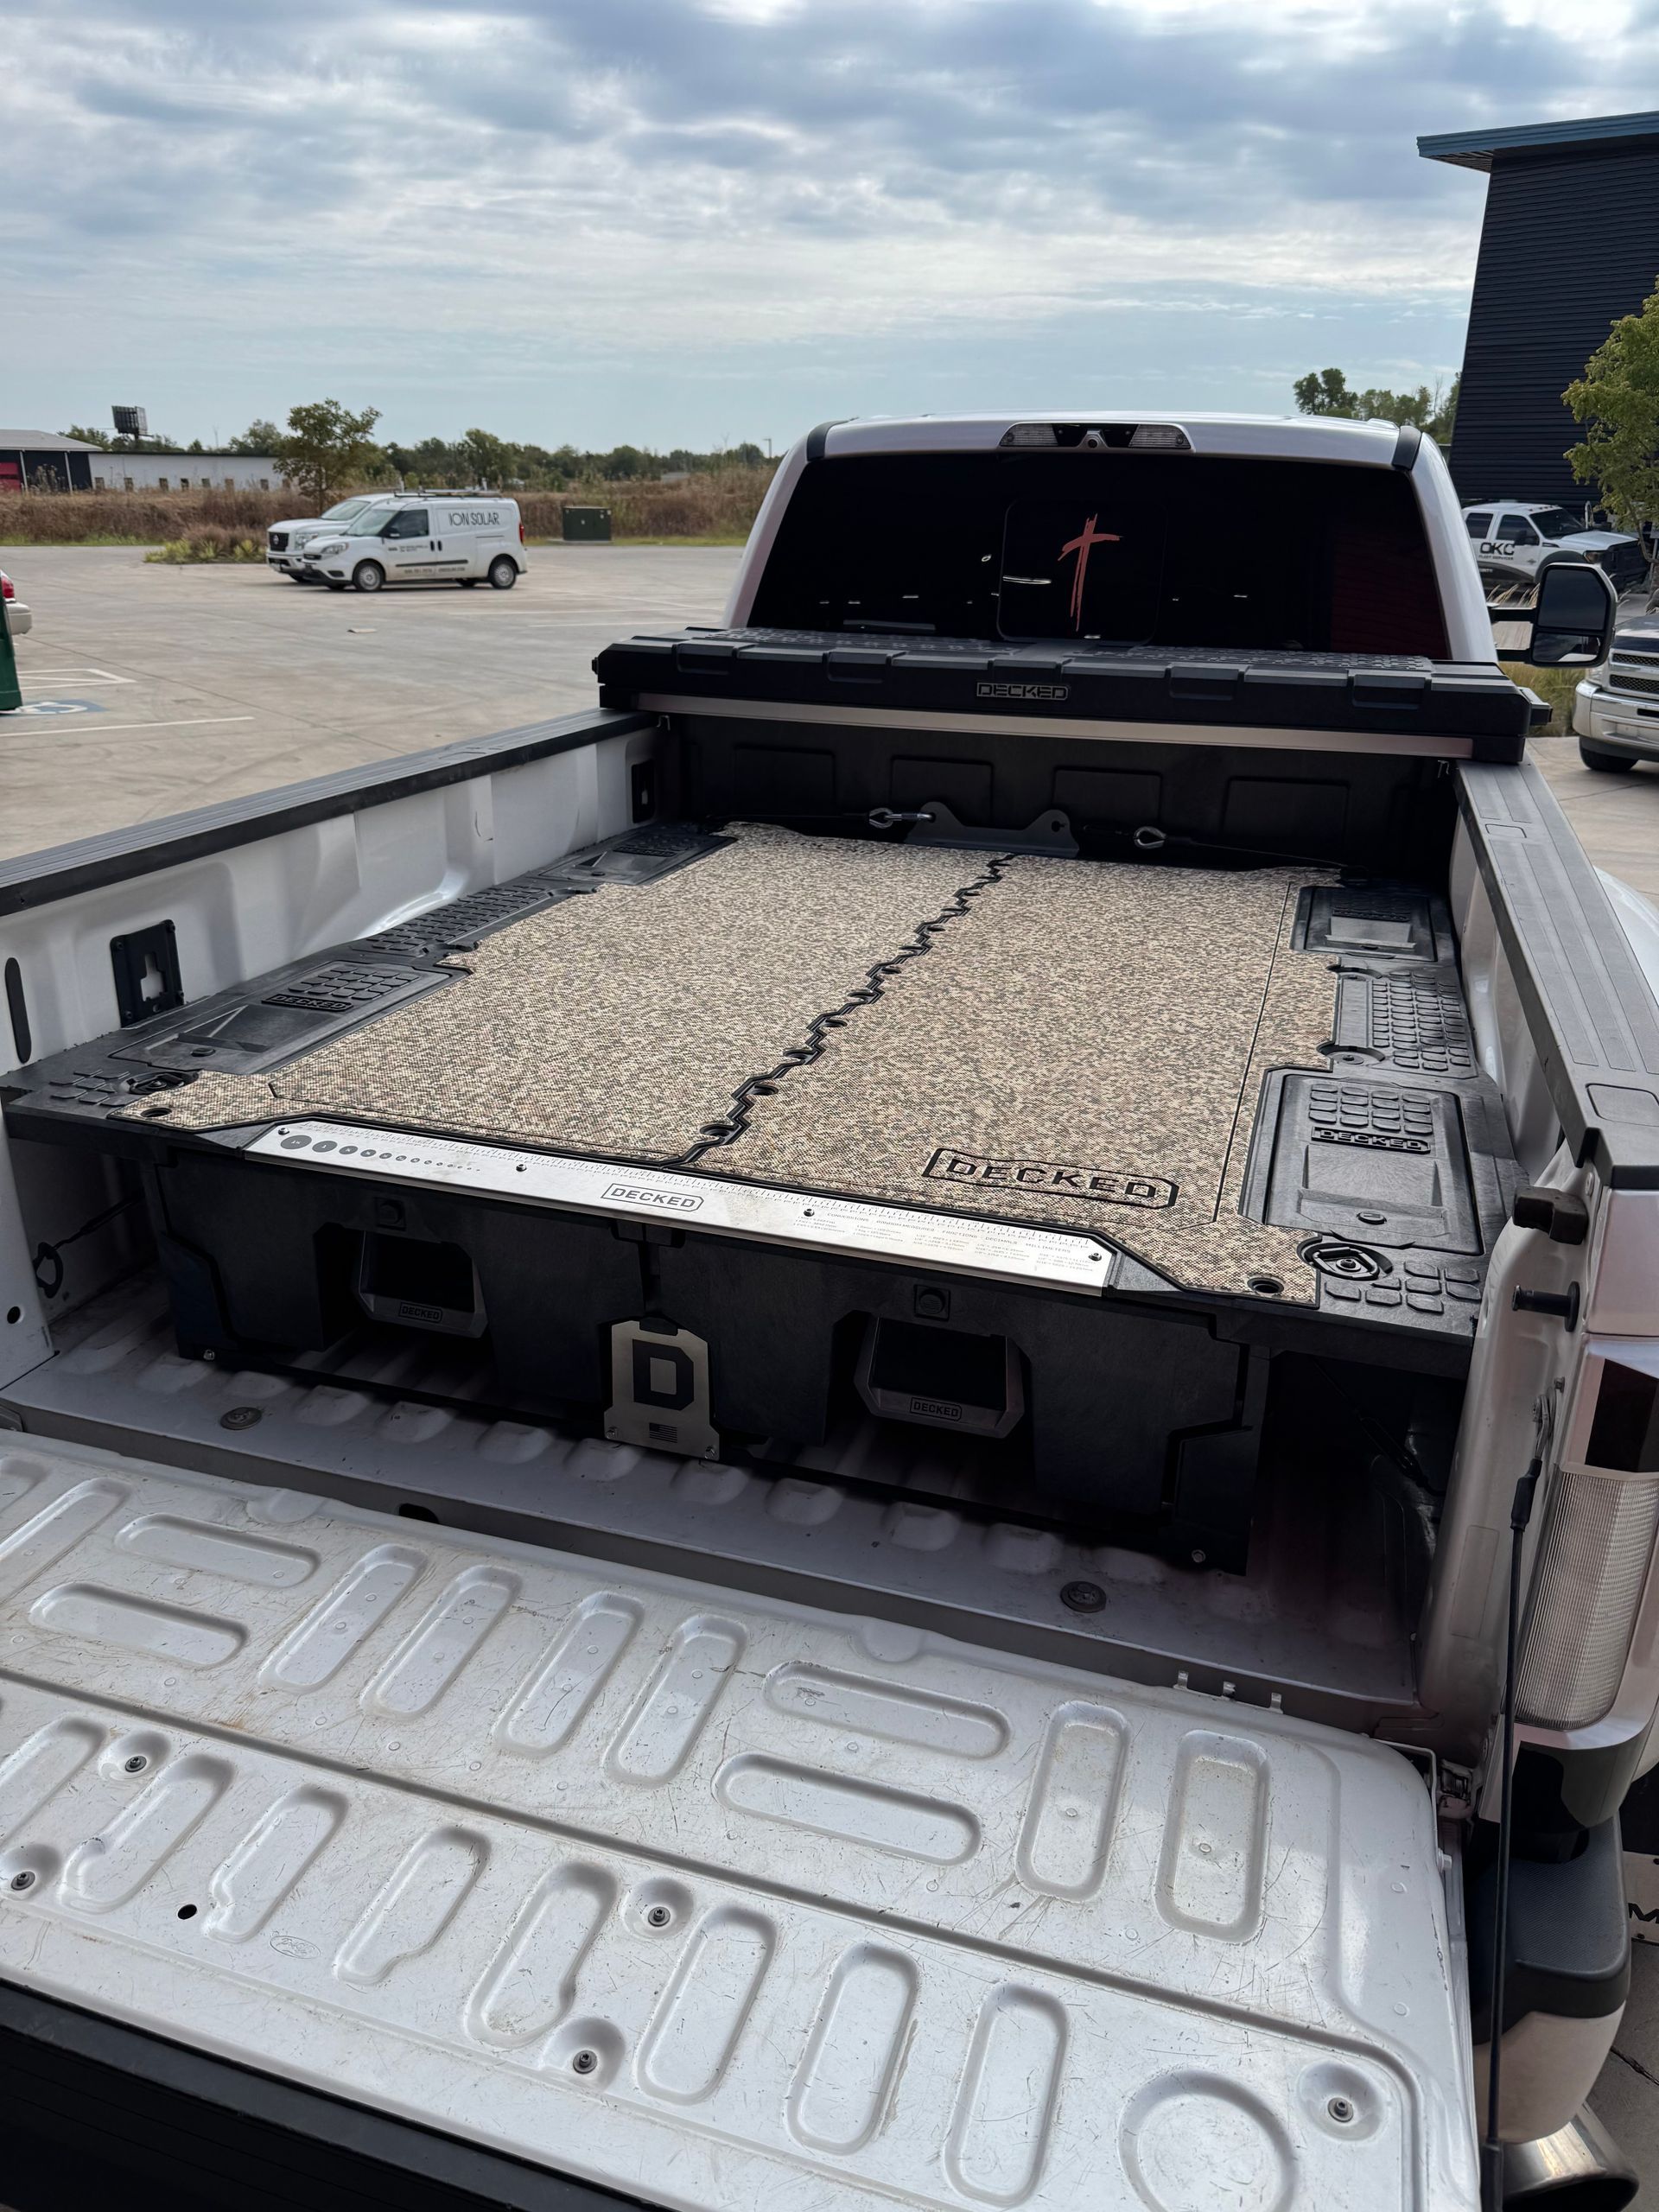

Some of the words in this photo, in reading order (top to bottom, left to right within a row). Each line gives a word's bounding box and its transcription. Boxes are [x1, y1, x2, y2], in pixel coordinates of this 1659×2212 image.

[449, 512, 469, 525] ION
[470, 512, 500, 525] SOLAR
[1480, 542, 1515, 556] OKC
[978, 683, 1067, 699] DECKED
[269, 994, 346, 1010] DECKED
[1319, 1128, 1422, 1150] DECKED
[946, 1159, 1156, 1198] DECKED
[610, 1187, 696, 1208] DECKED
[402, 1306, 440, 1319] DECKED
[632, 1339, 694, 1411] D
[913, 1402, 958, 1417] DECKED
